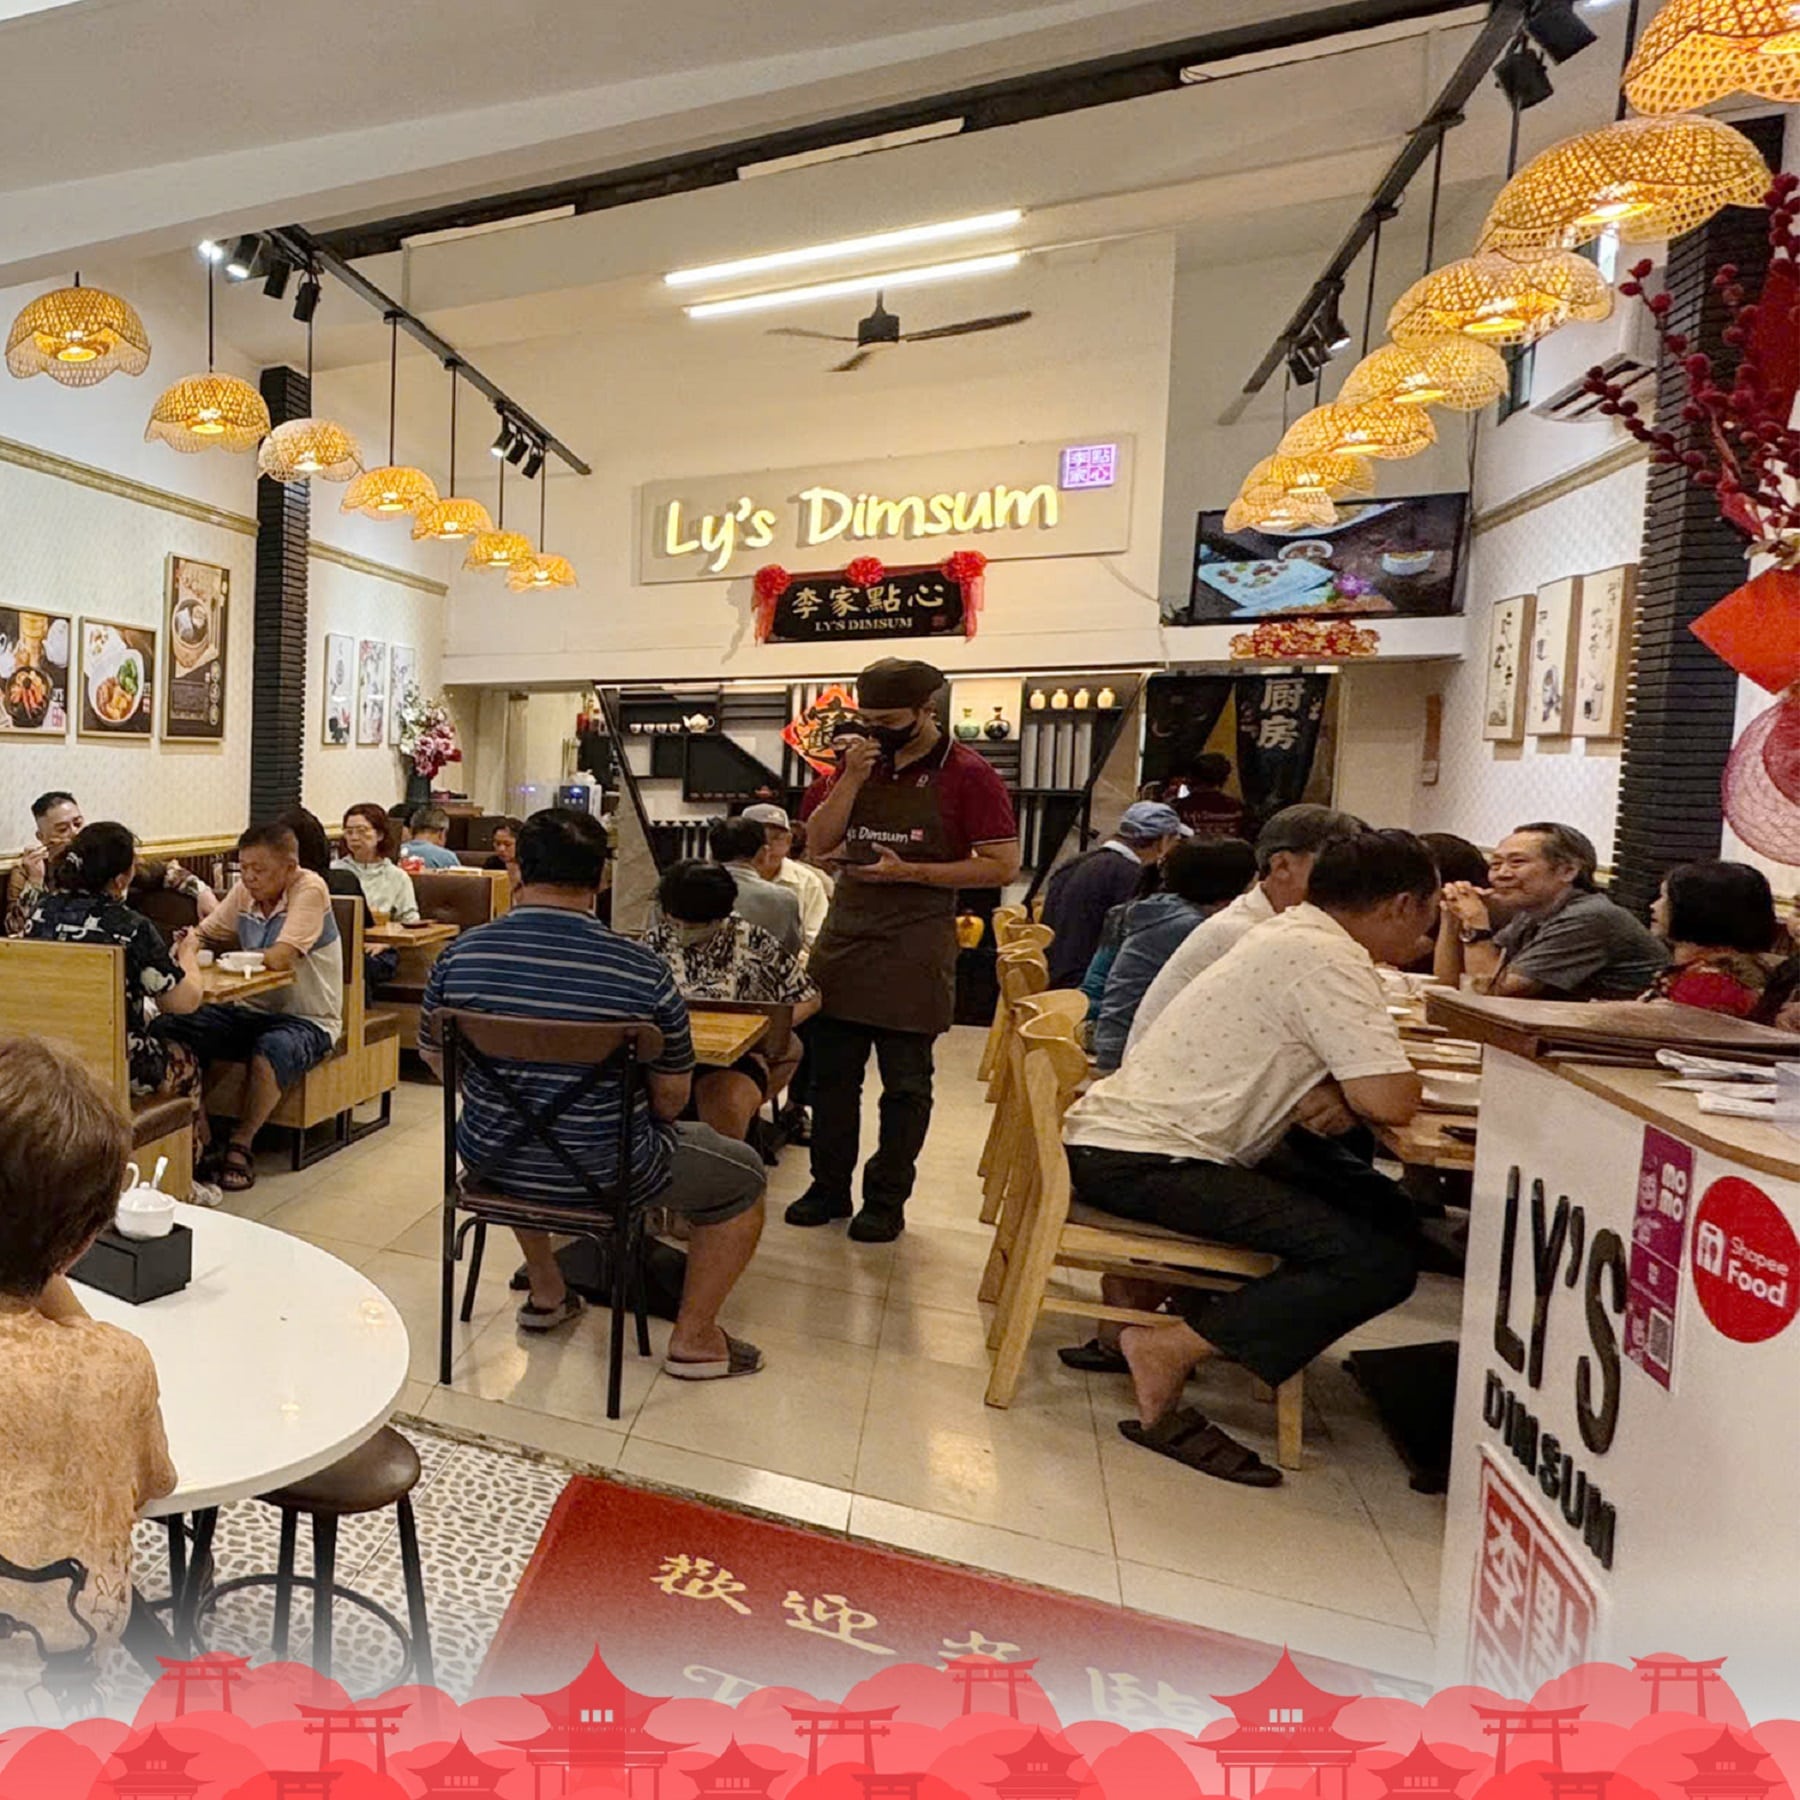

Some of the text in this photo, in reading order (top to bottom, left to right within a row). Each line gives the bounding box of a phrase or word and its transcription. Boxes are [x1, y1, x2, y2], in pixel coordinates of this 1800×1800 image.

[666, 484, 1058, 573] Ly's Dimsum
[791, 583, 945, 620] 李家點心
[815, 616, 913, 632] LY'S DIMSUM
[1256, 677, 1307, 751] 厨房
[858, 826, 908, 844] Dimsum
[1730, 1236, 1789, 1277] Shopee
[1727, 1259, 1788, 1308] Food
[1494, 1164, 1627, 1456] LY'S
[1482, 1368, 1617, 1572] DIMSUM
